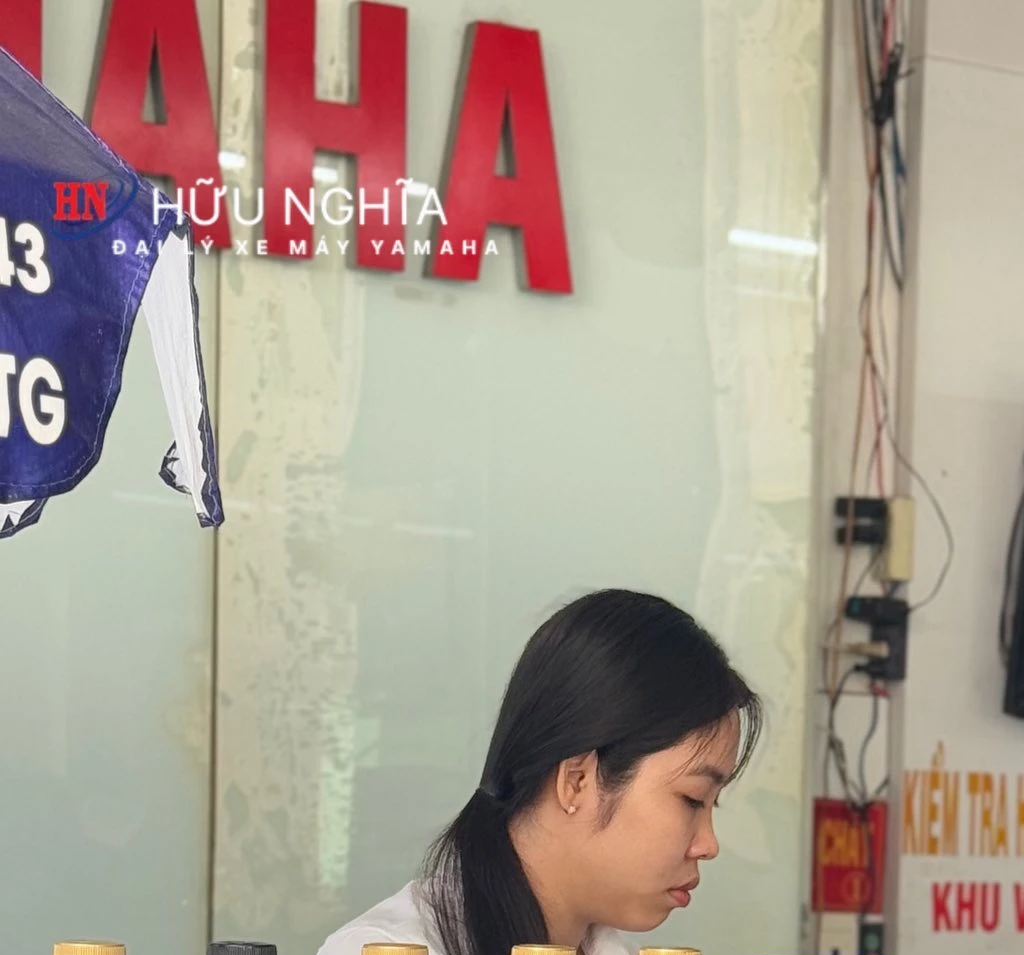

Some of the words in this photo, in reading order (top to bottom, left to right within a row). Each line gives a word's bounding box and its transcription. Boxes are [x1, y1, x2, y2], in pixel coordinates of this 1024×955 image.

[902, 740, 960, 856] KIỂM
[967, 772, 1008, 857] TRA
[932, 881, 1000, 933] KHU
